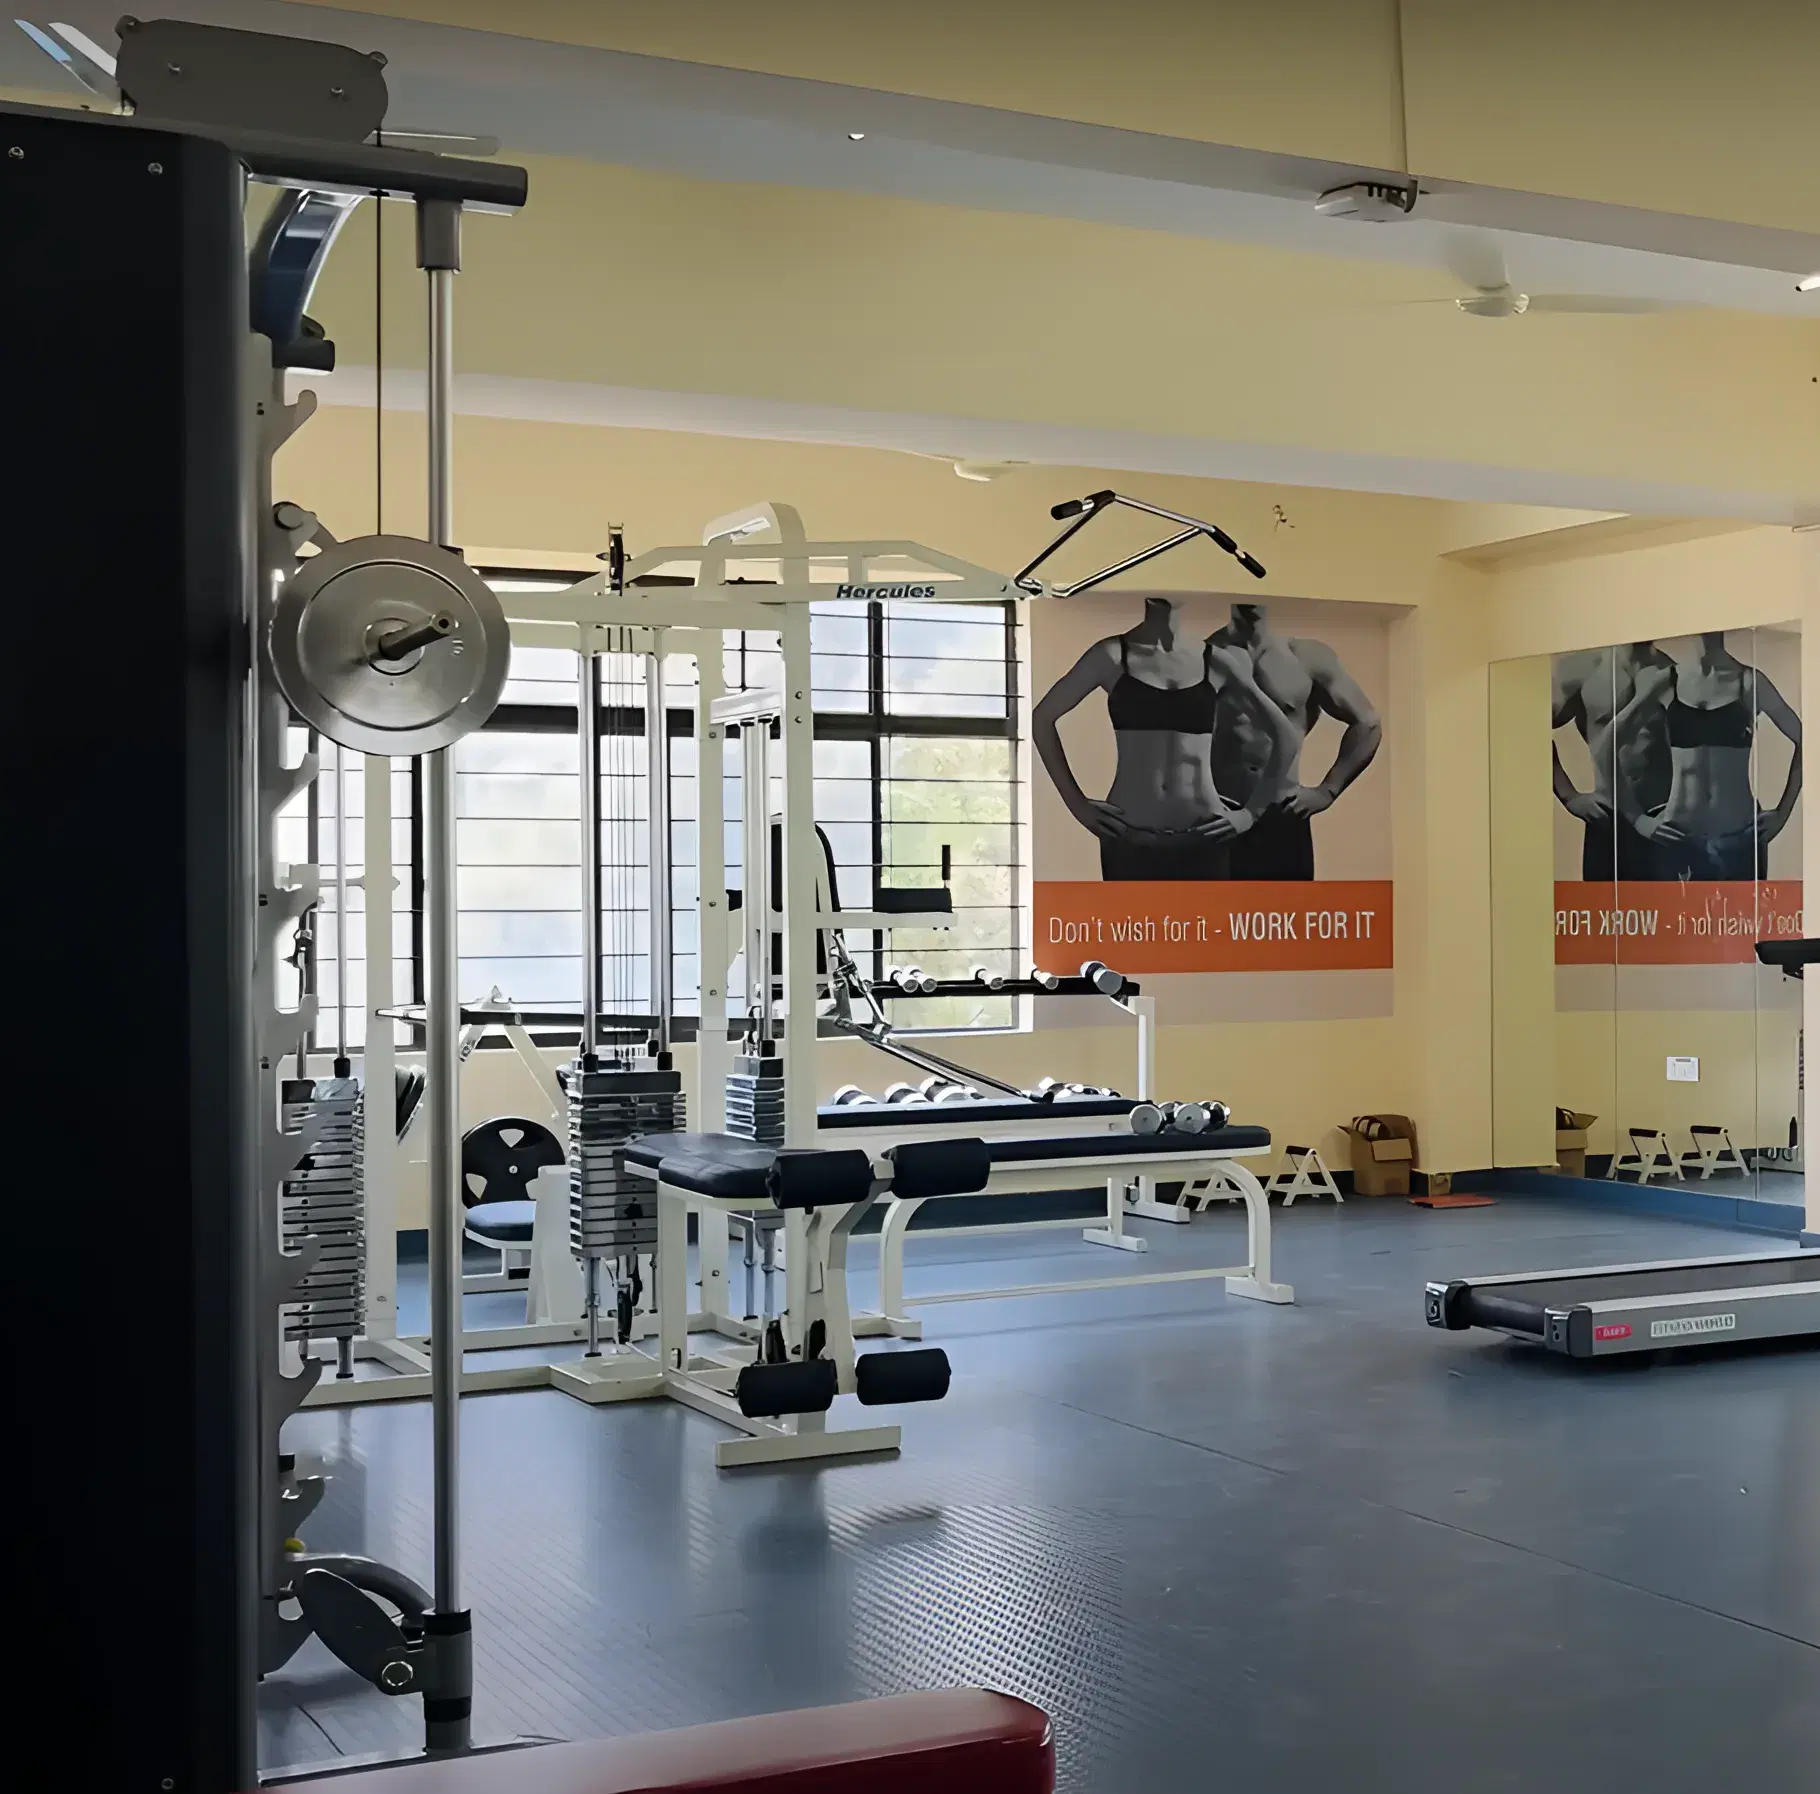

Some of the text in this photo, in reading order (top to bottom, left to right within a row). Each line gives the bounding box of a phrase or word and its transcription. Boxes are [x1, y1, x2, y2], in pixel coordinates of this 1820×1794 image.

[836, 584, 935, 599] Hercules
[1049, 916, 1103, 943] Don't
[1110, 915, 1156, 942] wish
[1163, 915, 1190, 942] for
[1197, 915, 1208, 942] it
[1229, 911, 1297, 940] WORK
[1305, 911, 1347, 939] FOR
[1355, 911, 1375, 939] IT
